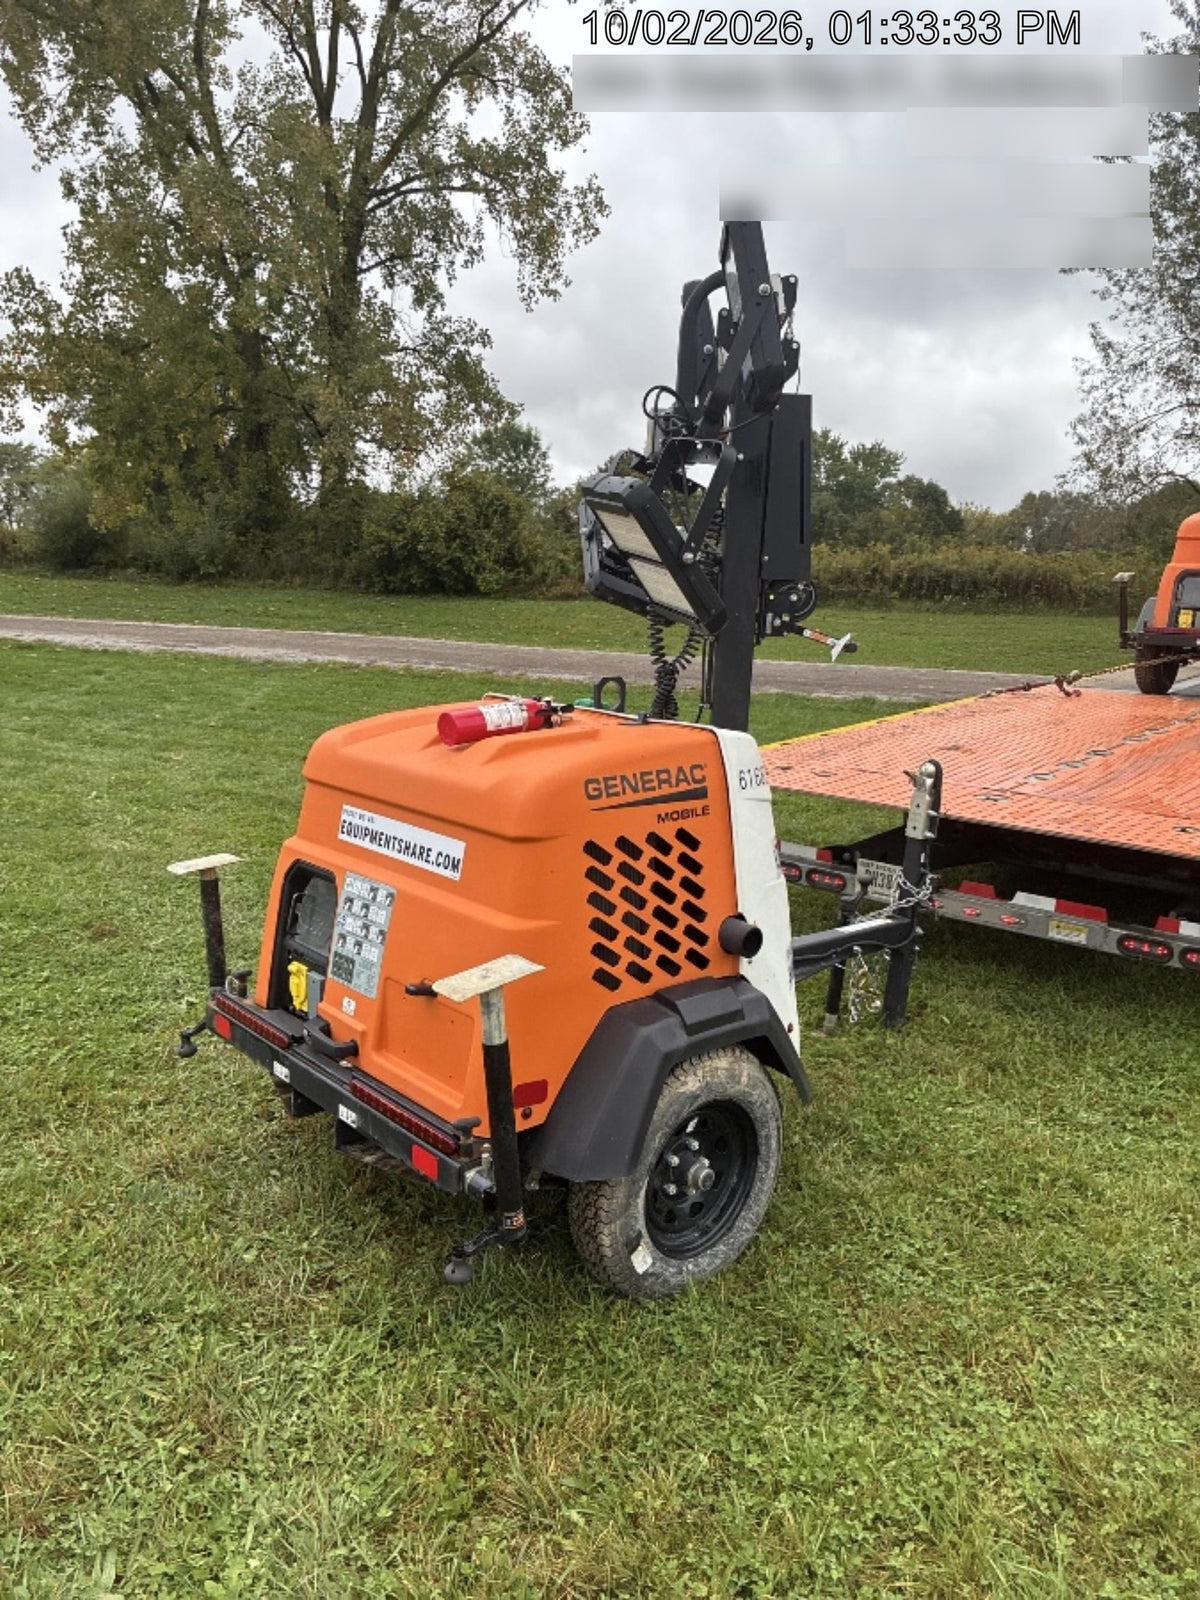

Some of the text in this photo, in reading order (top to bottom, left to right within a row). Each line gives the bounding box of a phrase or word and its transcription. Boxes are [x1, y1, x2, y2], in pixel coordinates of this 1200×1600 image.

[584, 763, 706, 800] GENERAC
[657, 805, 711, 824] MOBILE
[340, 819, 461, 874] EQUIPMENTSHARE.COM
